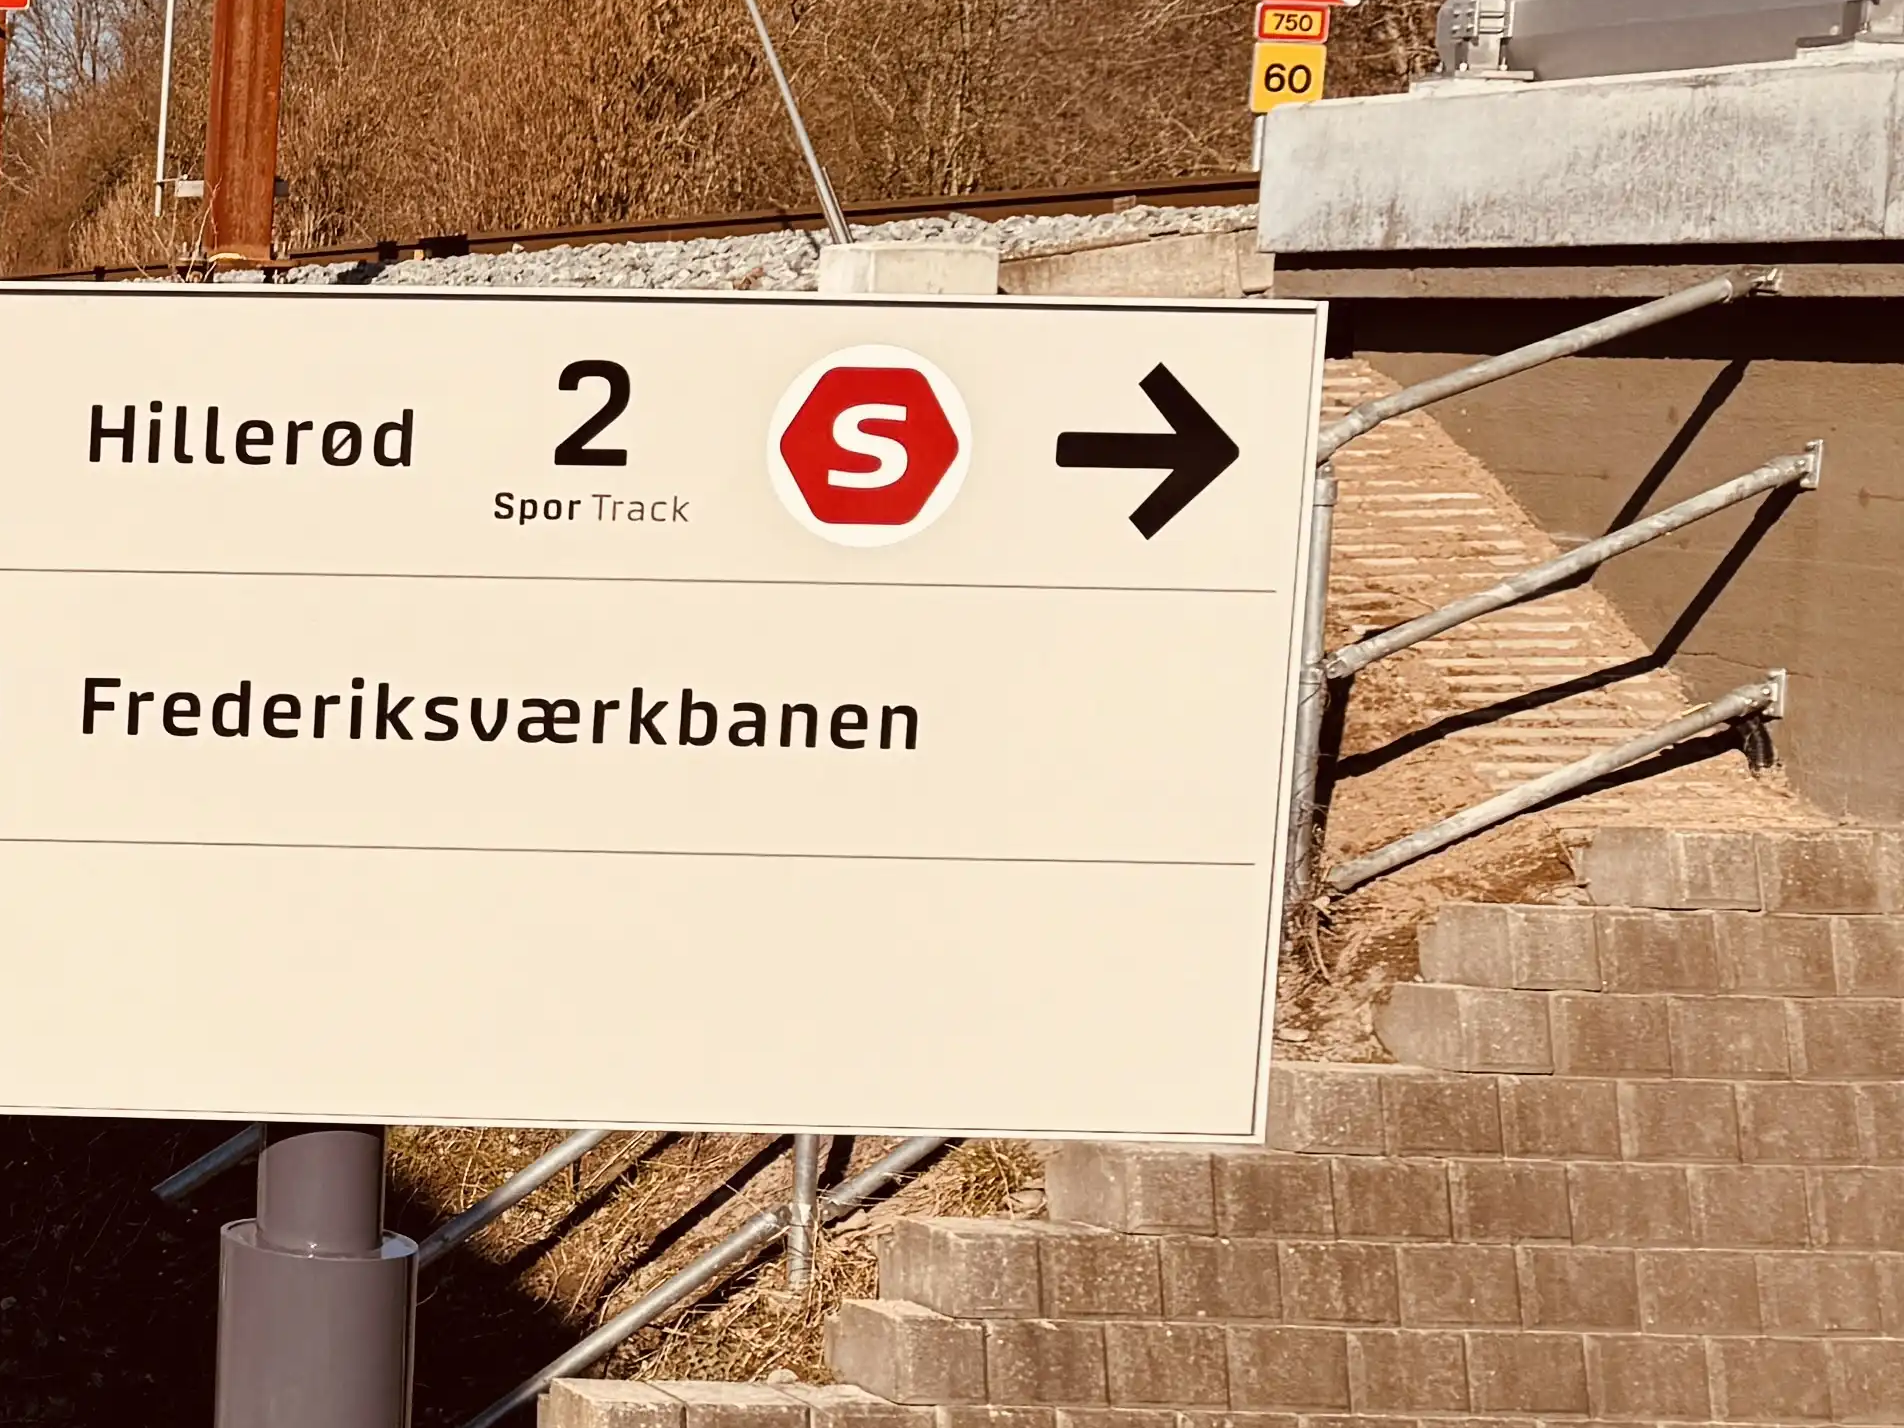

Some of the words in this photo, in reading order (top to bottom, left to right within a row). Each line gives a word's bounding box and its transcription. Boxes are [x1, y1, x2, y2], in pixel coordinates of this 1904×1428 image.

[1273, 13, 1313, 31] 750
[1264, 63, 1312, 93] 60
[89, 400, 414, 467] Hillerød
[554, 359, 631, 466] 2
[493, 492, 581, 525] Spor
[591, 493, 690, 523] Track
[81, 676, 919, 750] Frederiksværkbanen
